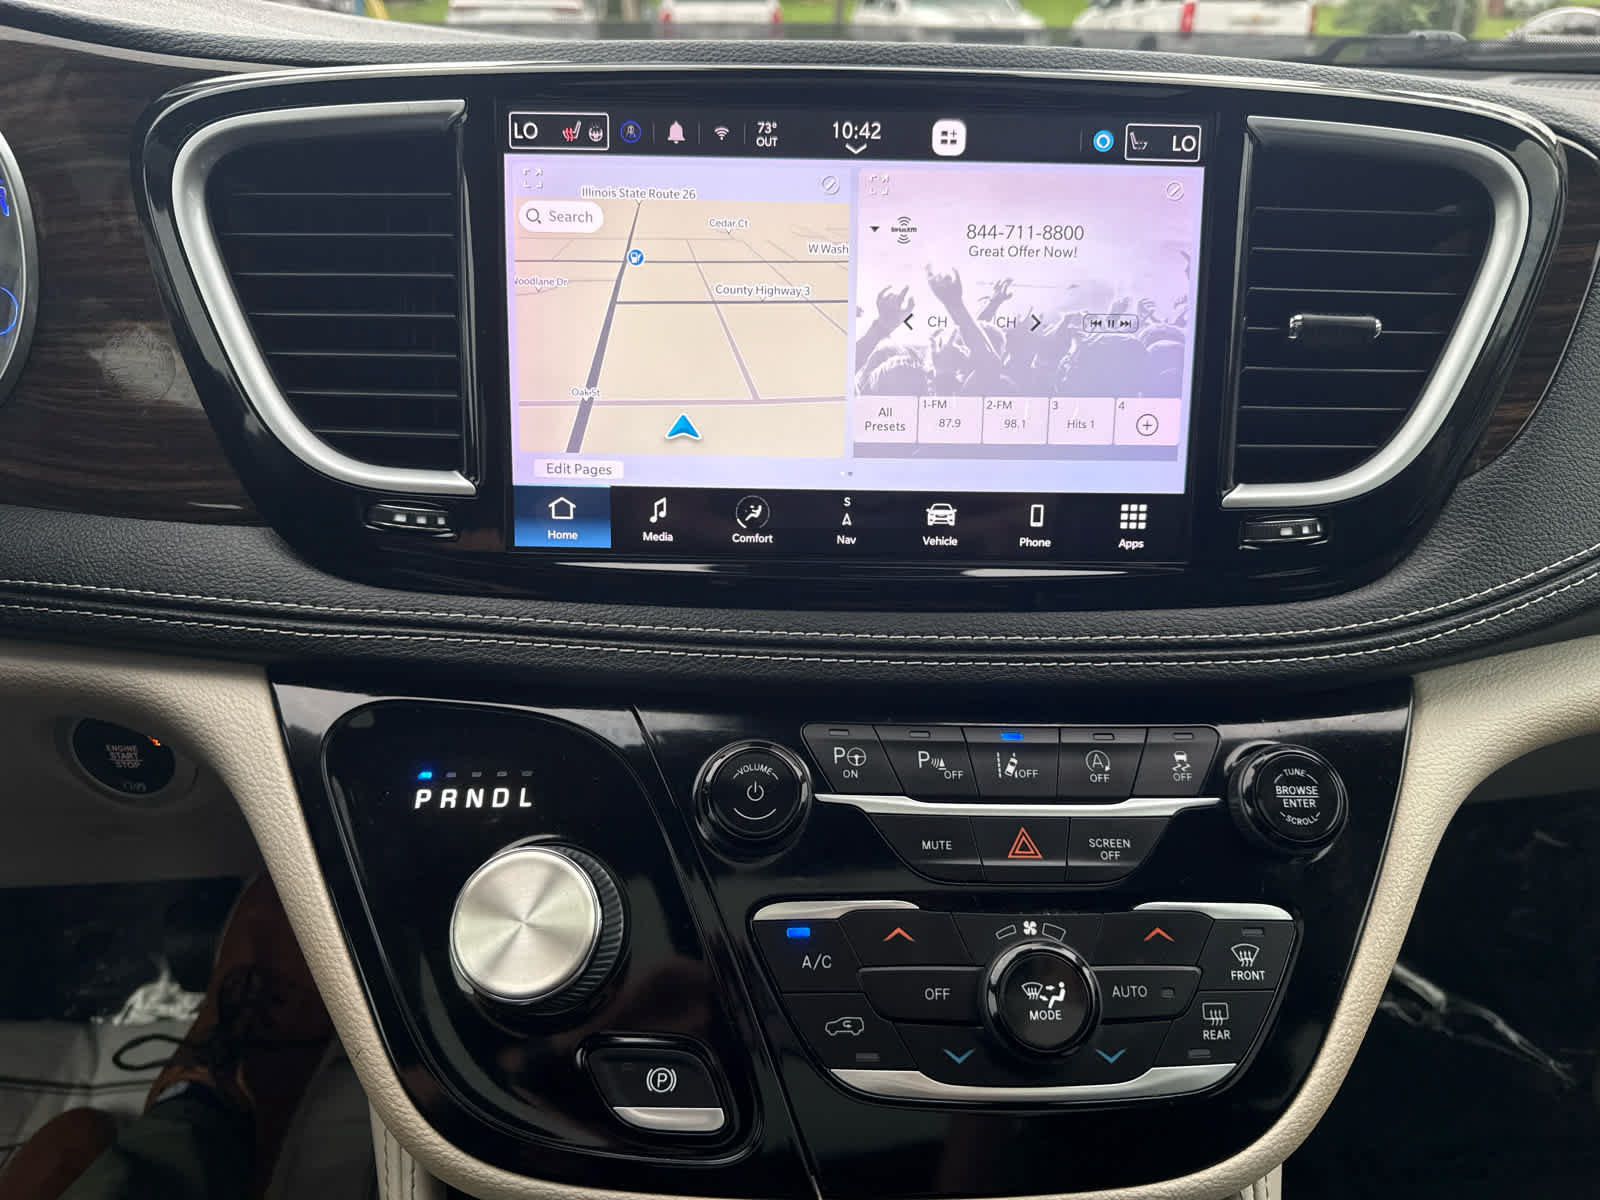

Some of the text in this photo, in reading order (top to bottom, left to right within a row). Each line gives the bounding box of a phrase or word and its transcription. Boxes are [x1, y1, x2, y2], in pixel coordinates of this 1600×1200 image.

[514, 122, 539, 140] LO
[831, 120, 882, 141] 10:42
[756, 137, 778, 148] OUT
[1172, 136, 1197, 152] LO
[581, 188, 696, 199] Illinois State Route 26
[548, 210, 593, 224] Search
[709, 218, 748, 228] Cedar Ct
[966, 224, 1084, 240] 844-711-8800
[808, 244, 848, 255] W Wash
[969, 246, 1078, 258] Great Offer Now!
[715, 285, 810, 298] County Highway 3
[927, 317, 947, 328] CH
[996, 317, 1017, 329] CH
[571, 388, 589, 397] Oak
[923, 400, 947, 409] 1-FM
[986, 400, 1012, 409] 2-FM
[1052, 401, 1058, 410] 3
[1118, 401, 1125, 410] 4
[878, 407, 893, 417] All
[864, 420, 905, 432] Presets
[938, 418, 961, 429] 87.9
[1003, 419, 1026, 429] 98.1
[1067, 419, 1095, 429] Hits 1
[546, 463, 612, 477] Edit Pages
[548, 530, 578, 540] Home
[643, 532, 673, 542] Media
[732, 533, 773, 544] Comfort
[837, 535, 857, 545] Nav
[923, 536, 958, 547] Vehicle
[1019, 537, 1051, 548] Phone
[1119, 538, 1144, 550] Apps
[736, 764, 773, 776] VOLUME
[843, 769, 859, 778] ON
[944, 770, 964, 780] OFF
[1018, 768, 1038, 779] OFF
[1283, 768, 1307, 778] TUNE
[1089, 773, 1110, 783] OFF
[1173, 772, 1193, 782] OFF
[1275, 785, 1319, 796] BROWSE
[1283, 798, 1316, 809] ENTER
[1286, 814, 1319, 827] SCROLL
[921, 840, 952, 851] MUTE
[1088, 838, 1131, 850] SCREEN
[1099, 850, 1120, 861] OFF
[802, 955, 832, 970] A/C
[1231, 970, 1265, 981] FRONT
[924, 987, 951, 1001] OFF
[1112, 986, 1148, 998] AUTO
[1029, 1010, 1062, 1021] MODE
[1202, 1029, 1231, 1040] REAR
